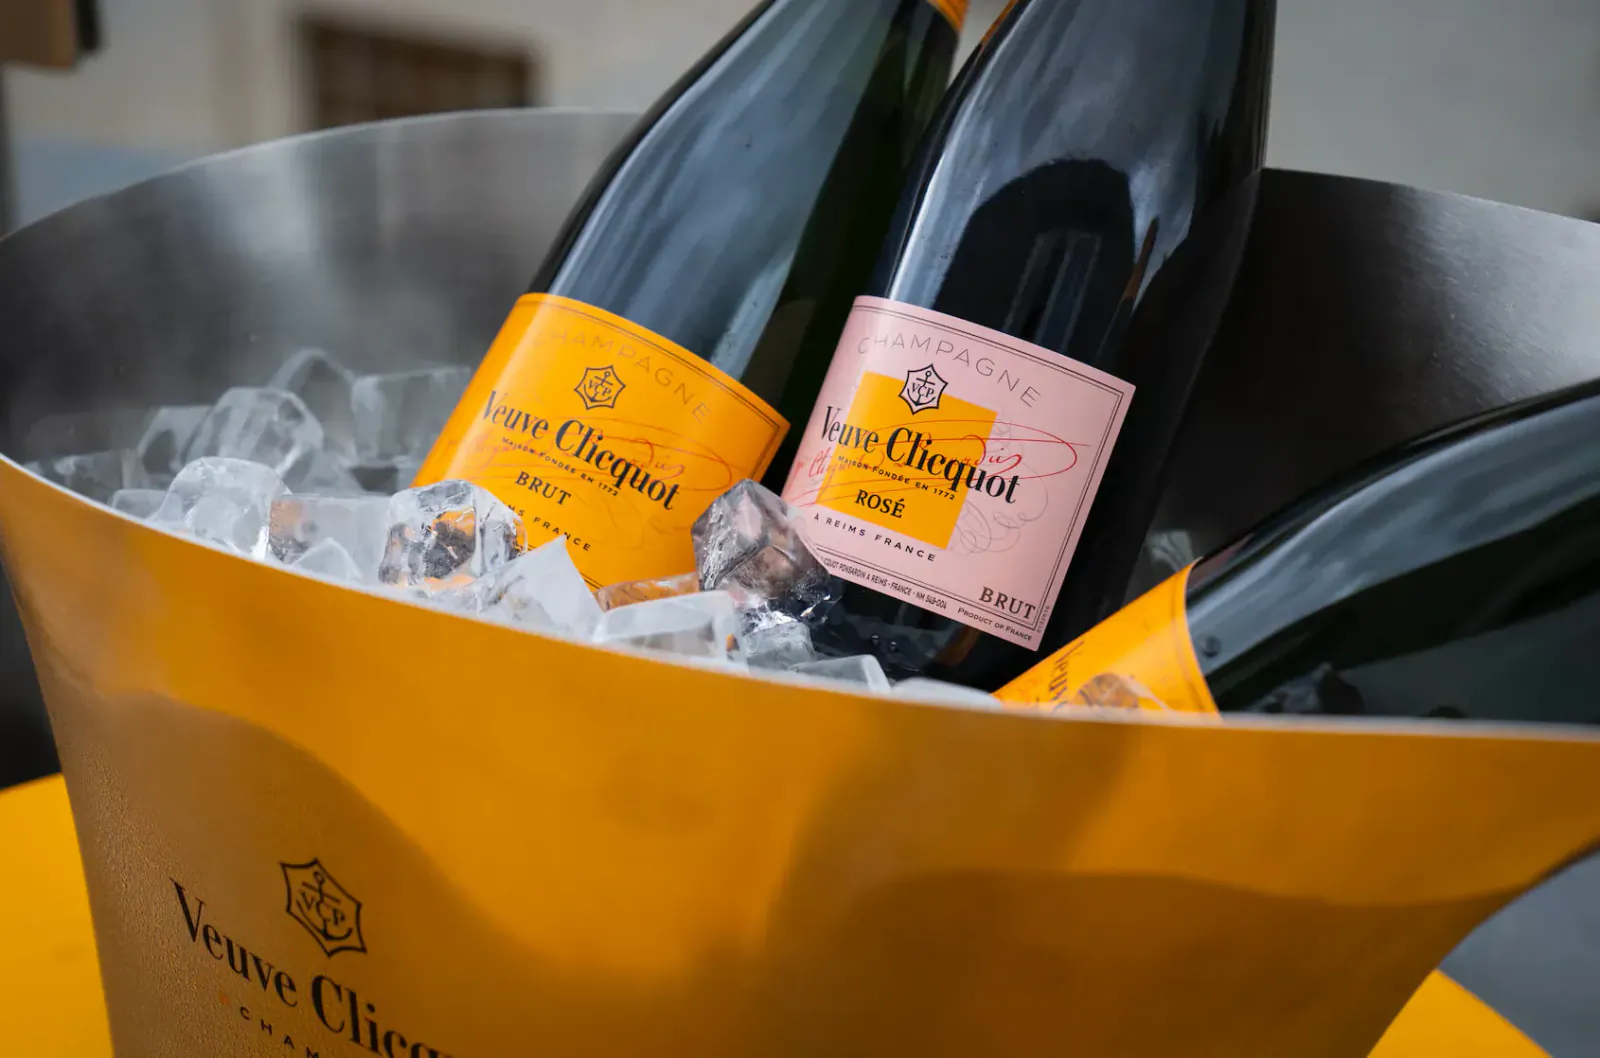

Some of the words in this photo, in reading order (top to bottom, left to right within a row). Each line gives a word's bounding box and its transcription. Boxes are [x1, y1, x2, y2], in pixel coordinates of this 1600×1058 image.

[857, 332, 1042, 408] CHAMPAGNE
[482, 390, 549, 439] Veuve
[555, 419, 680, 510] Clicquot
[820, 405, 880, 454] Veuve
[886, 427, 1021, 504] Clicquot
[514, 471, 572, 506] BRUT
[580, 472, 594, 484] EN
[598, 482, 619, 497] 1772
[915, 481, 929, 491] EN
[933, 487, 956, 500] 1772
[854, 488, 906, 519] ROSÉ
[533, 516, 592, 552] FRANCE
[825, 516, 867, 538] REIMS
[874, 533, 936, 563] FRANCE
[871, 574, 888, 587] REIMS
[891, 582, 912, 596] FRANCE
[979, 586, 1036, 620] BRUT
[957, 607, 993, 626] PRODUCT
[994, 622, 1005, 630] OF
[1005, 625, 1032, 641] FRANCE
[169, 877, 299, 1008] Veuve
